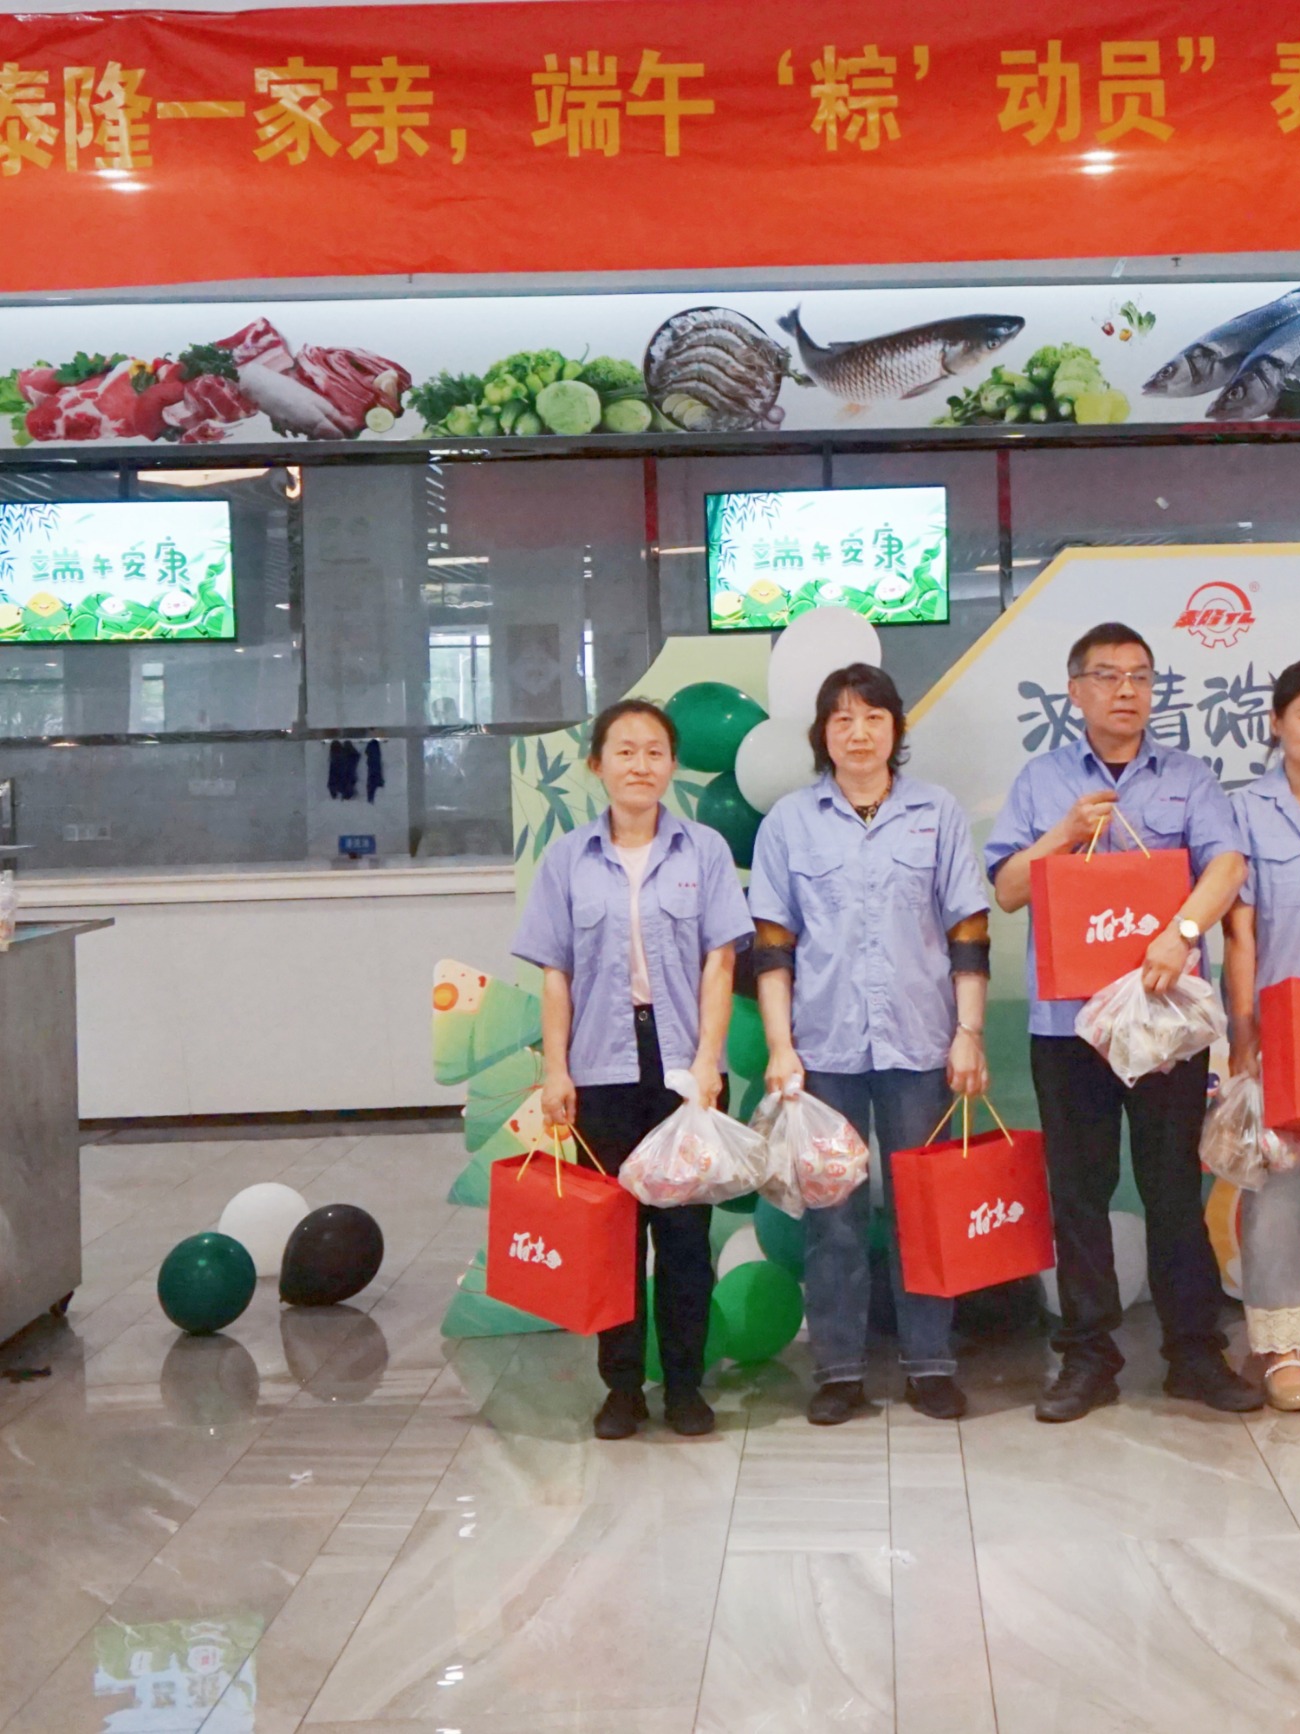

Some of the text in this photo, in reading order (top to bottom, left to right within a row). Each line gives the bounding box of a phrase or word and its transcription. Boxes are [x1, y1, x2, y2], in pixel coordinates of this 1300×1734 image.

[30, 535, 191, 584] 端午安康
[753, 522, 906, 570] 端午安康
